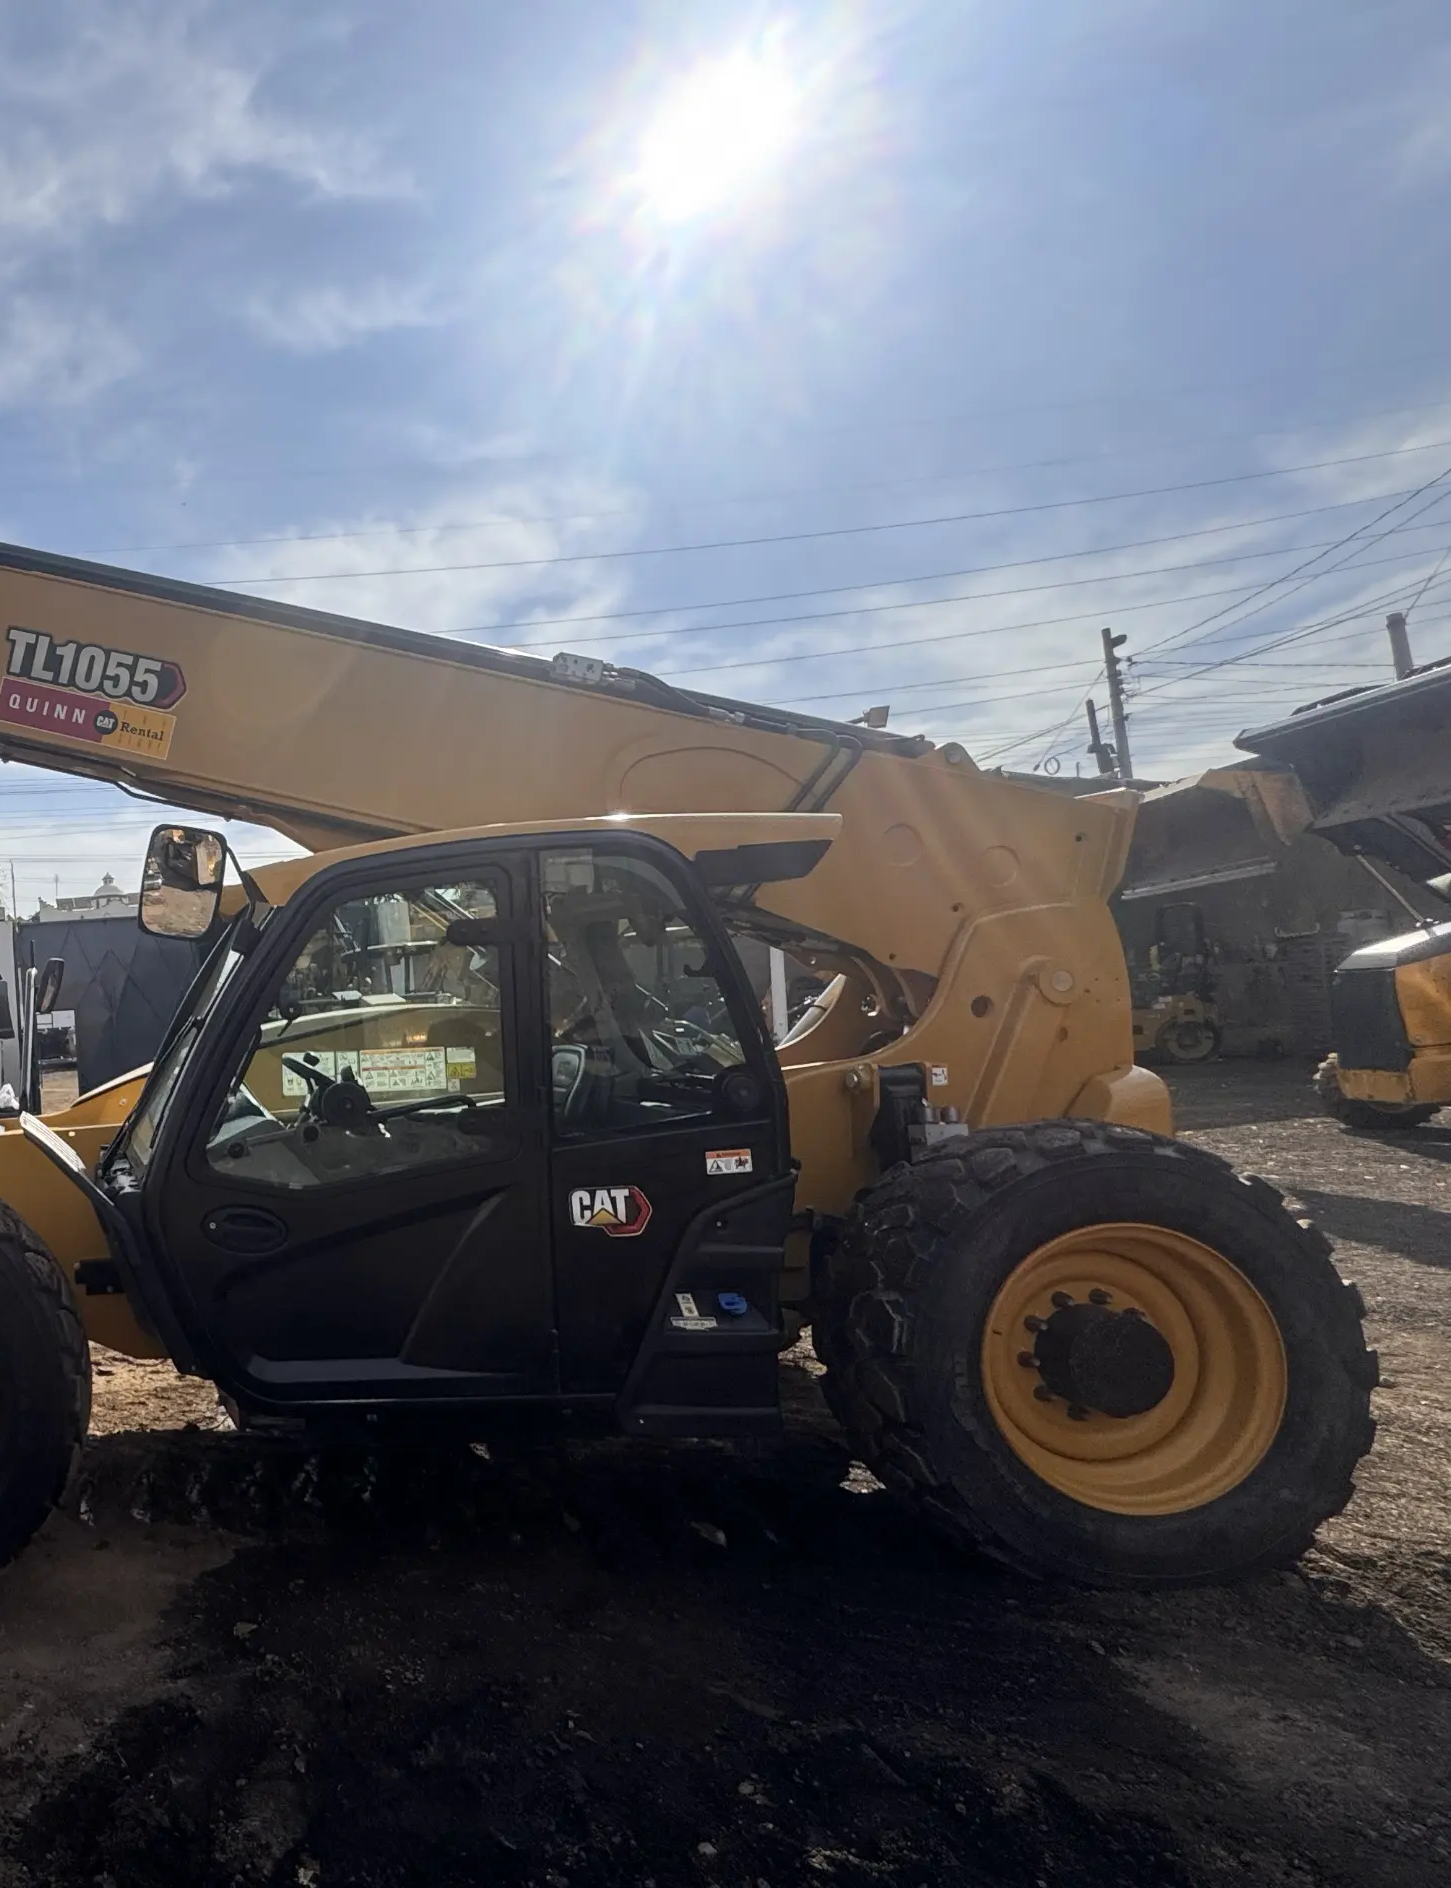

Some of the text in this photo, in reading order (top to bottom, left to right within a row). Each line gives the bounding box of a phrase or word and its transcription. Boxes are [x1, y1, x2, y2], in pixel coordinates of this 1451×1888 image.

[9, 629, 162, 703] TL1055
[9, 693, 165, 742] QUINN CAT Rental
[571, 1188, 630, 1225] CAT
